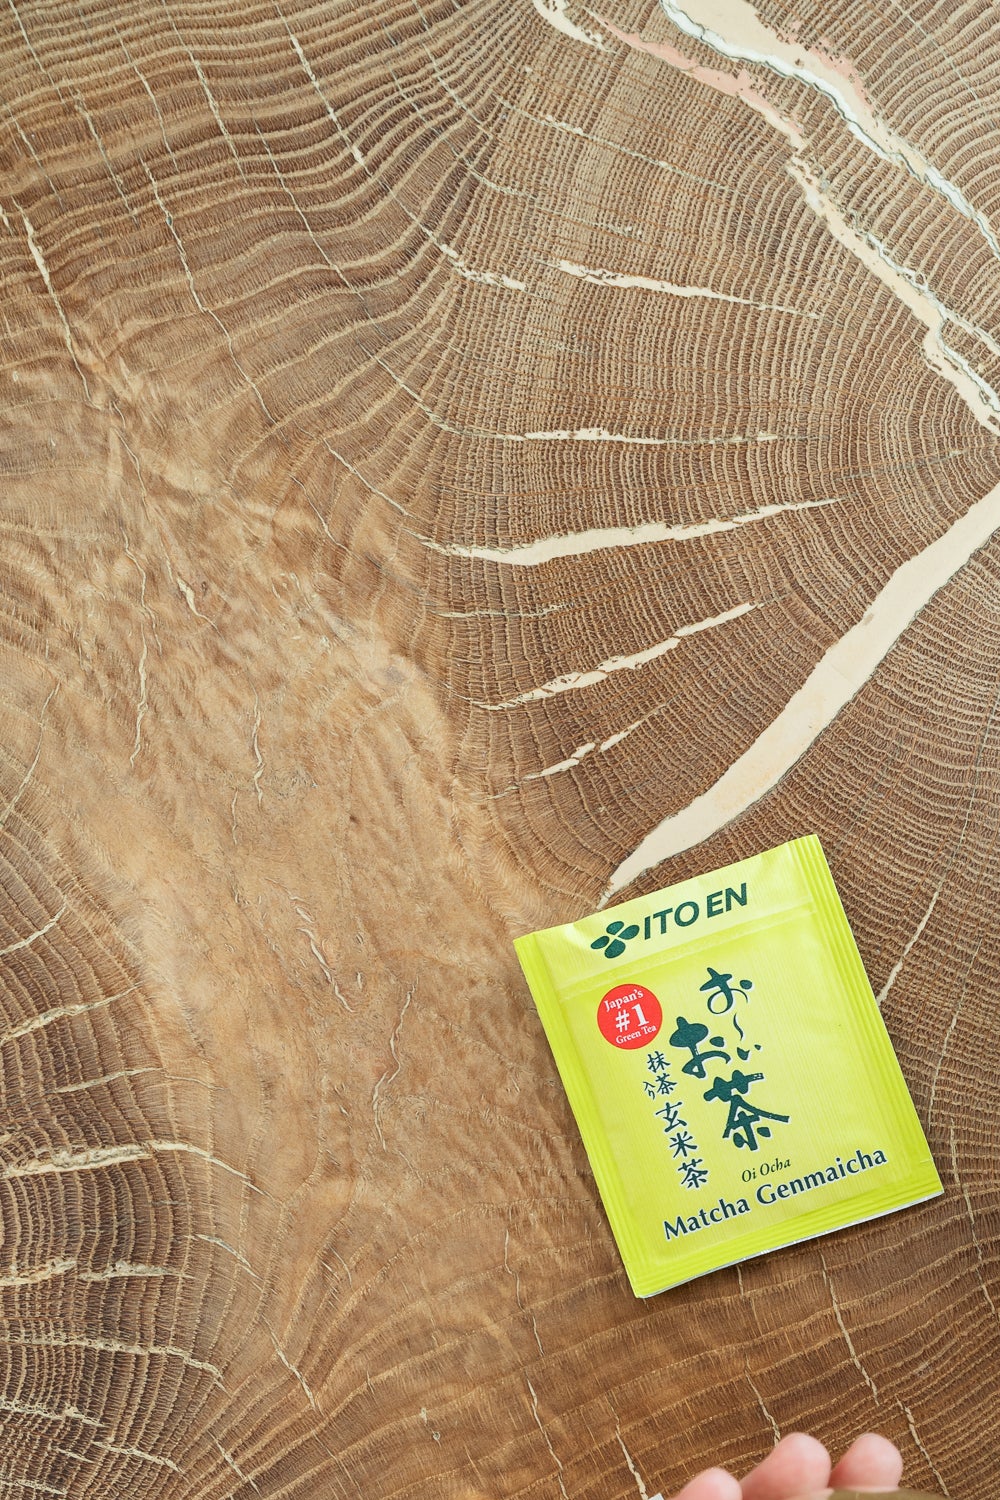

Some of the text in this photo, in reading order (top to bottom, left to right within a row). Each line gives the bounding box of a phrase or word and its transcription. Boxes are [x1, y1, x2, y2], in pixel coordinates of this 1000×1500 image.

[644, 882, 748, 940] ITO EN
[615, 1003, 649, 1033] #1
[615, 1024, 657, 1044] Green Tea
[742, 1158, 791, 1183] Oi Ocha
[664, 1149, 887, 1240] Matcha Genmaicha
